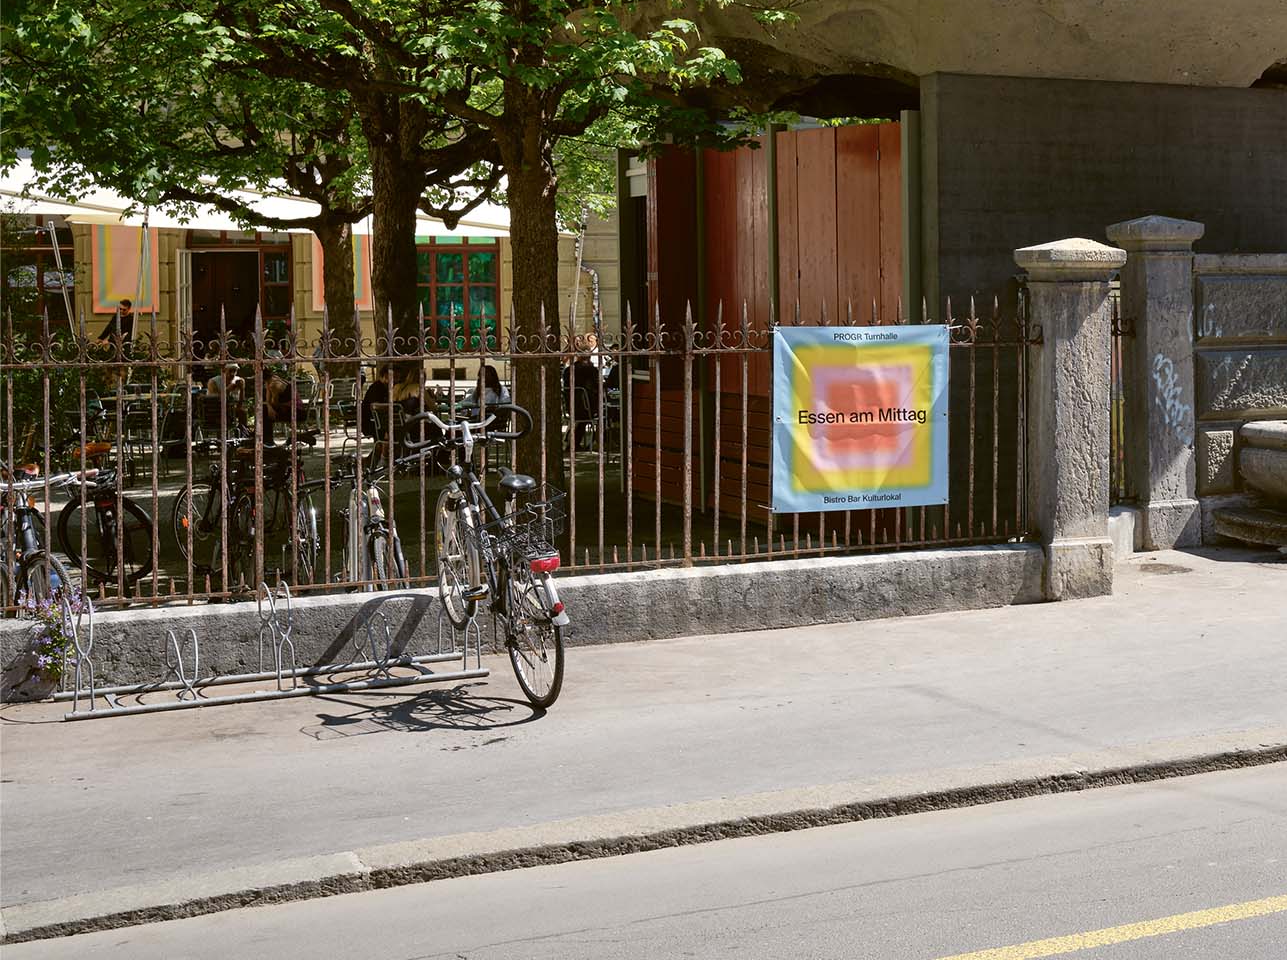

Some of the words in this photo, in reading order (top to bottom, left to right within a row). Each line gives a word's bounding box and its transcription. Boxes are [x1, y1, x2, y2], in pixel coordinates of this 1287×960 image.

[833, 332, 862, 340] PROGR
[864, 332, 898, 340] Turnhalle
[798, 410, 845, 424] Essen
[849, 411, 873, 423] am
[879, 408, 927, 424] Mittag
[823, 496, 846, 504] Bistro
[847, 495, 861, 503] Bar
[862, 493, 902, 502] Kulturlokal
